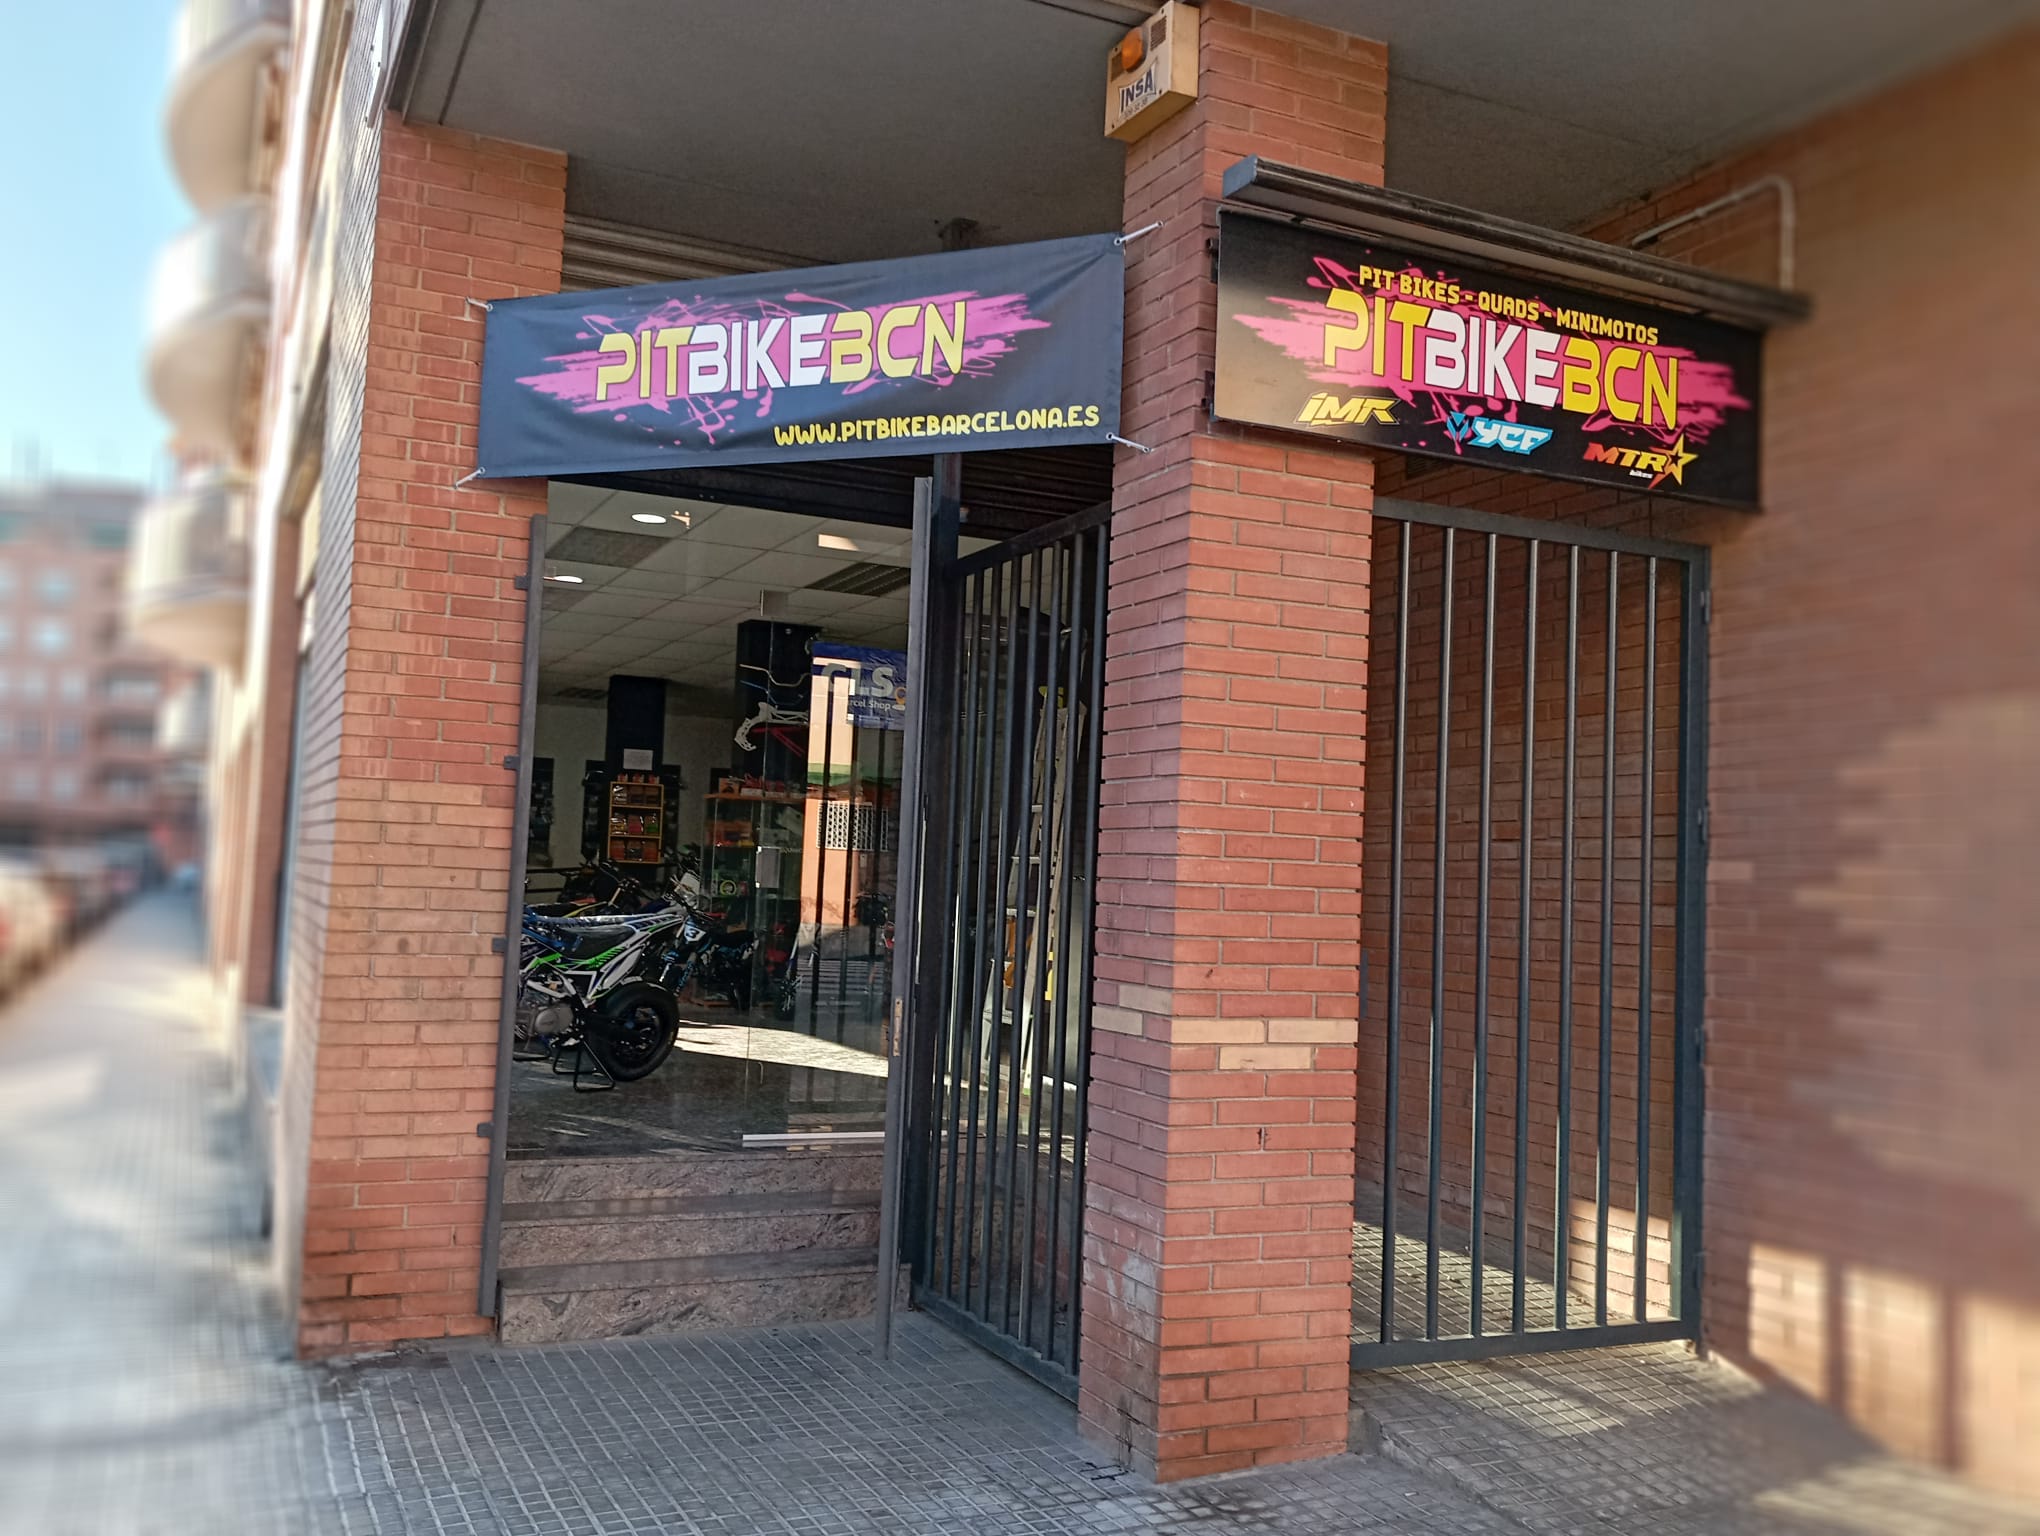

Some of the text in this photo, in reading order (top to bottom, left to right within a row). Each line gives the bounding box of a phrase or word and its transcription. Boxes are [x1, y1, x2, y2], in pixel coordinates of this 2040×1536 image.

[1120, 69, 1153, 113] INSA
[1359, 265, 1395, 291] PIT
[1400, 272, 1460, 305] BIKES
[1478, 291, 1539, 322] QUADS
[1556, 307, 1659, 346] MINIMOTOS
[596, 301, 967, 401] PITBIKEBCN
[1323, 288, 1679, 431] PITBIKEBCN
[774, 405, 1100, 447] WWW.PITBIKEBARCELONA.ES
[1583, 442, 1668, 473] MTR
[870, 699, 891, 712] Shop
